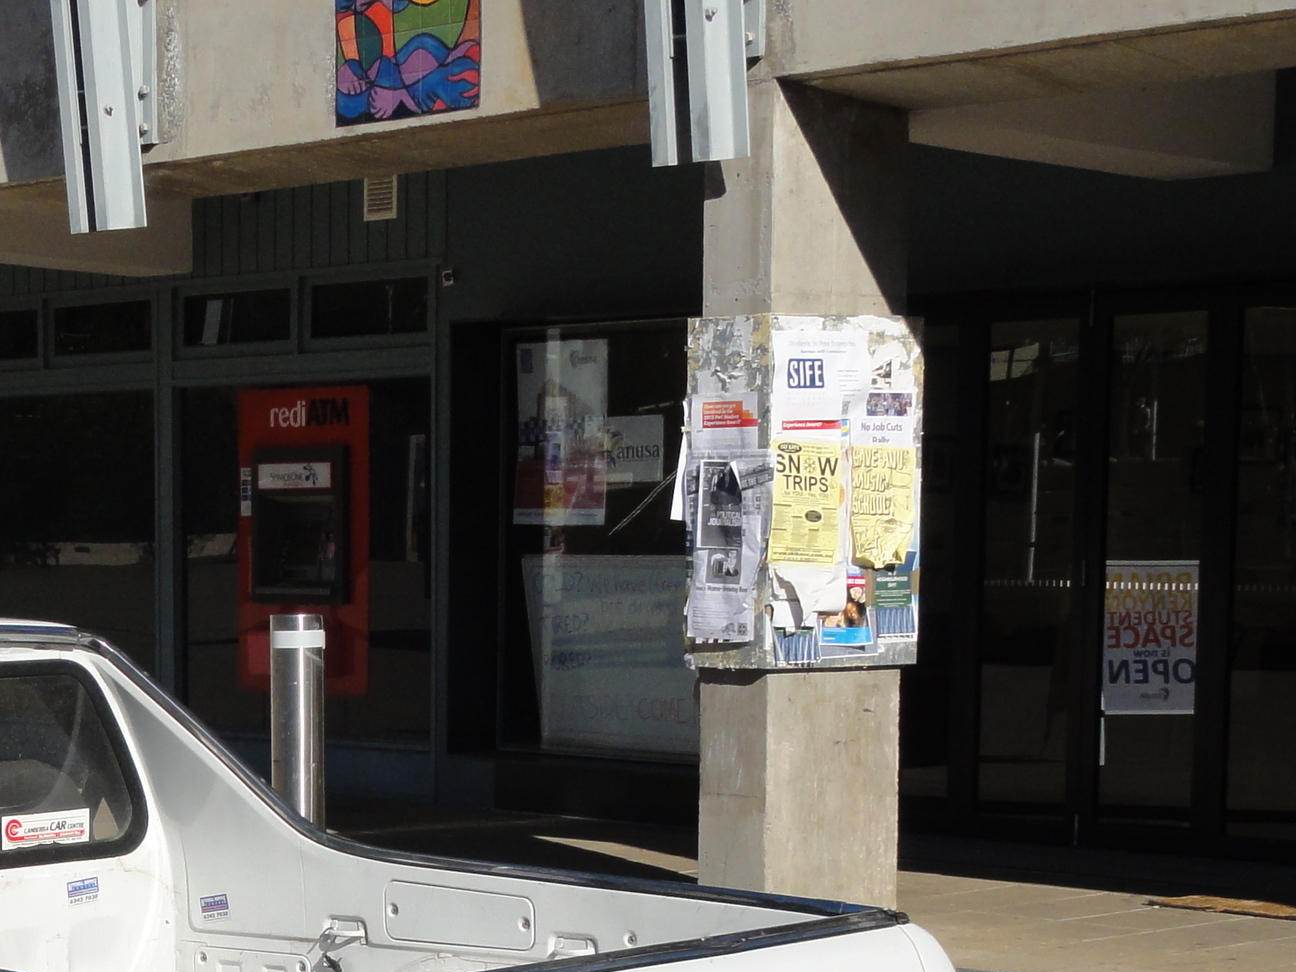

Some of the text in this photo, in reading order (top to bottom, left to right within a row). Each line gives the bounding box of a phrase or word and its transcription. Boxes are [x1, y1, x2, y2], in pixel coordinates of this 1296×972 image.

[789, 360, 823, 387] SIFE
[861, 422, 903, 431] No Job Cuts
[782, 474, 829, 493] TRIPS
[24, 826, 49, 834] CANBERRA
[50, 820, 67, 831] CAR
